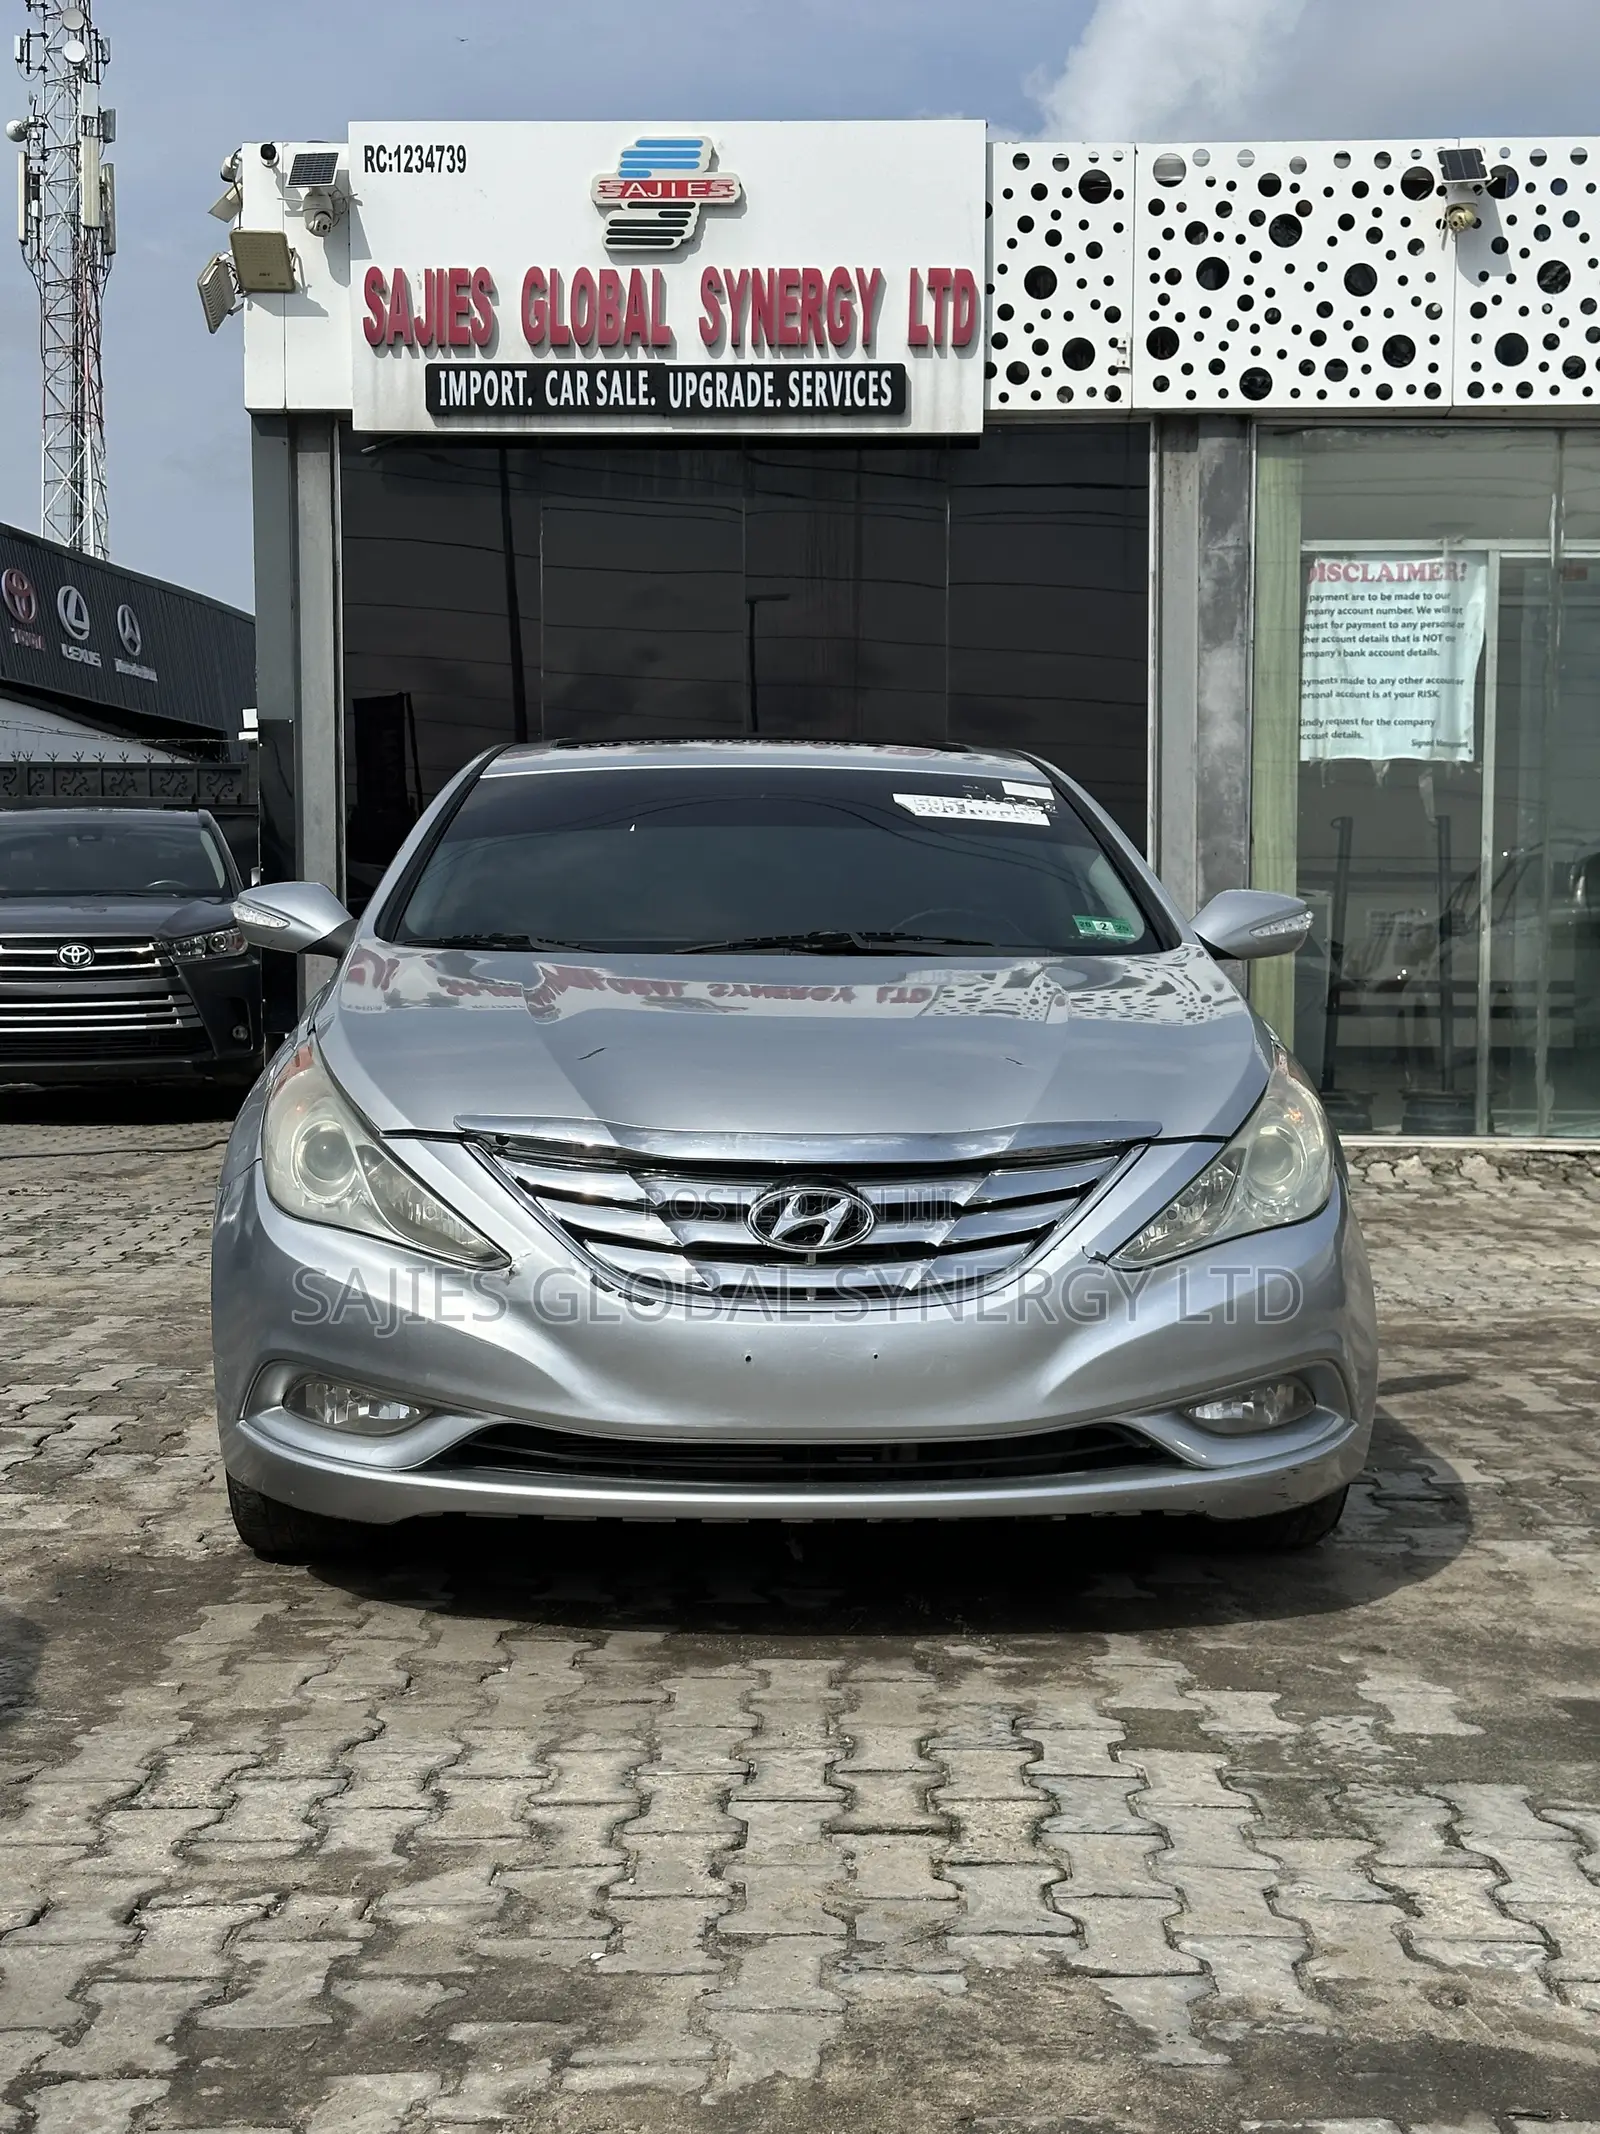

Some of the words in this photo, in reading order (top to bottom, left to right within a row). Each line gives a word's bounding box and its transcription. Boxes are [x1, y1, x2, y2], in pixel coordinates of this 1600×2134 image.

[363, 144, 467, 173] RC:1234739
[597, 179, 737, 199] SAJIES
[362, 266, 496, 347] SAJIES
[520, 266, 672, 347] GLOBAL
[698, 265, 882, 347] SYNERGY
[908, 267, 977, 347] LTD
[438, 369, 533, 407] IMPORT.
[545, 369, 590, 406] CAR
[596, 369, 656, 406] SALE.
[668, 370, 782, 409] UPGRADE.
[788, 369, 893, 407] SERVICES
[1309, 593, 1348, 603] payment
[1368, 593, 1378, 601] to
[1380, 592, 1392, 601] be
[1394, 592, 1421, 600] made
[1423, 592, 1433, 600] to
[1337, 607, 1374, 615] account
[1416, 606, 1432, 614] We
[1331, 621, 1344, 629] for
[1346, 622, 1386, 631] payment
[1401, 622, 1418, 630] any
[1358, 634, 1389, 643] details
[1391, 634, 1410, 642] that
[1412, 634, 1420, 642] is
[1423, 634, 1443, 642] NOT
[1343, 649, 1366, 657] bank
[1368, 649, 1405, 657] account
[1406, 648, 1440, 657] details.
[1300, 677, 1338, 687] ayments
[1340, 677, 1365, 685] made
[1367, 677, 1377, 685] to
[1380, 678, 1396, 686] any
[1398, 676, 1423, 685] other
[1300, 690, 1333, 699] ersonal
[1335, 691, 1370, 699] account
[1372, 690, 1380, 698] is
[1382, 690, 1392, 698] at
[1394, 692, 1415, 700] your
[1325, 718, 1359, 727] request
[1361, 717, 1374, 725] for
[1376, 718, 1391, 726] the
[1393, 719, 1436, 727] company
